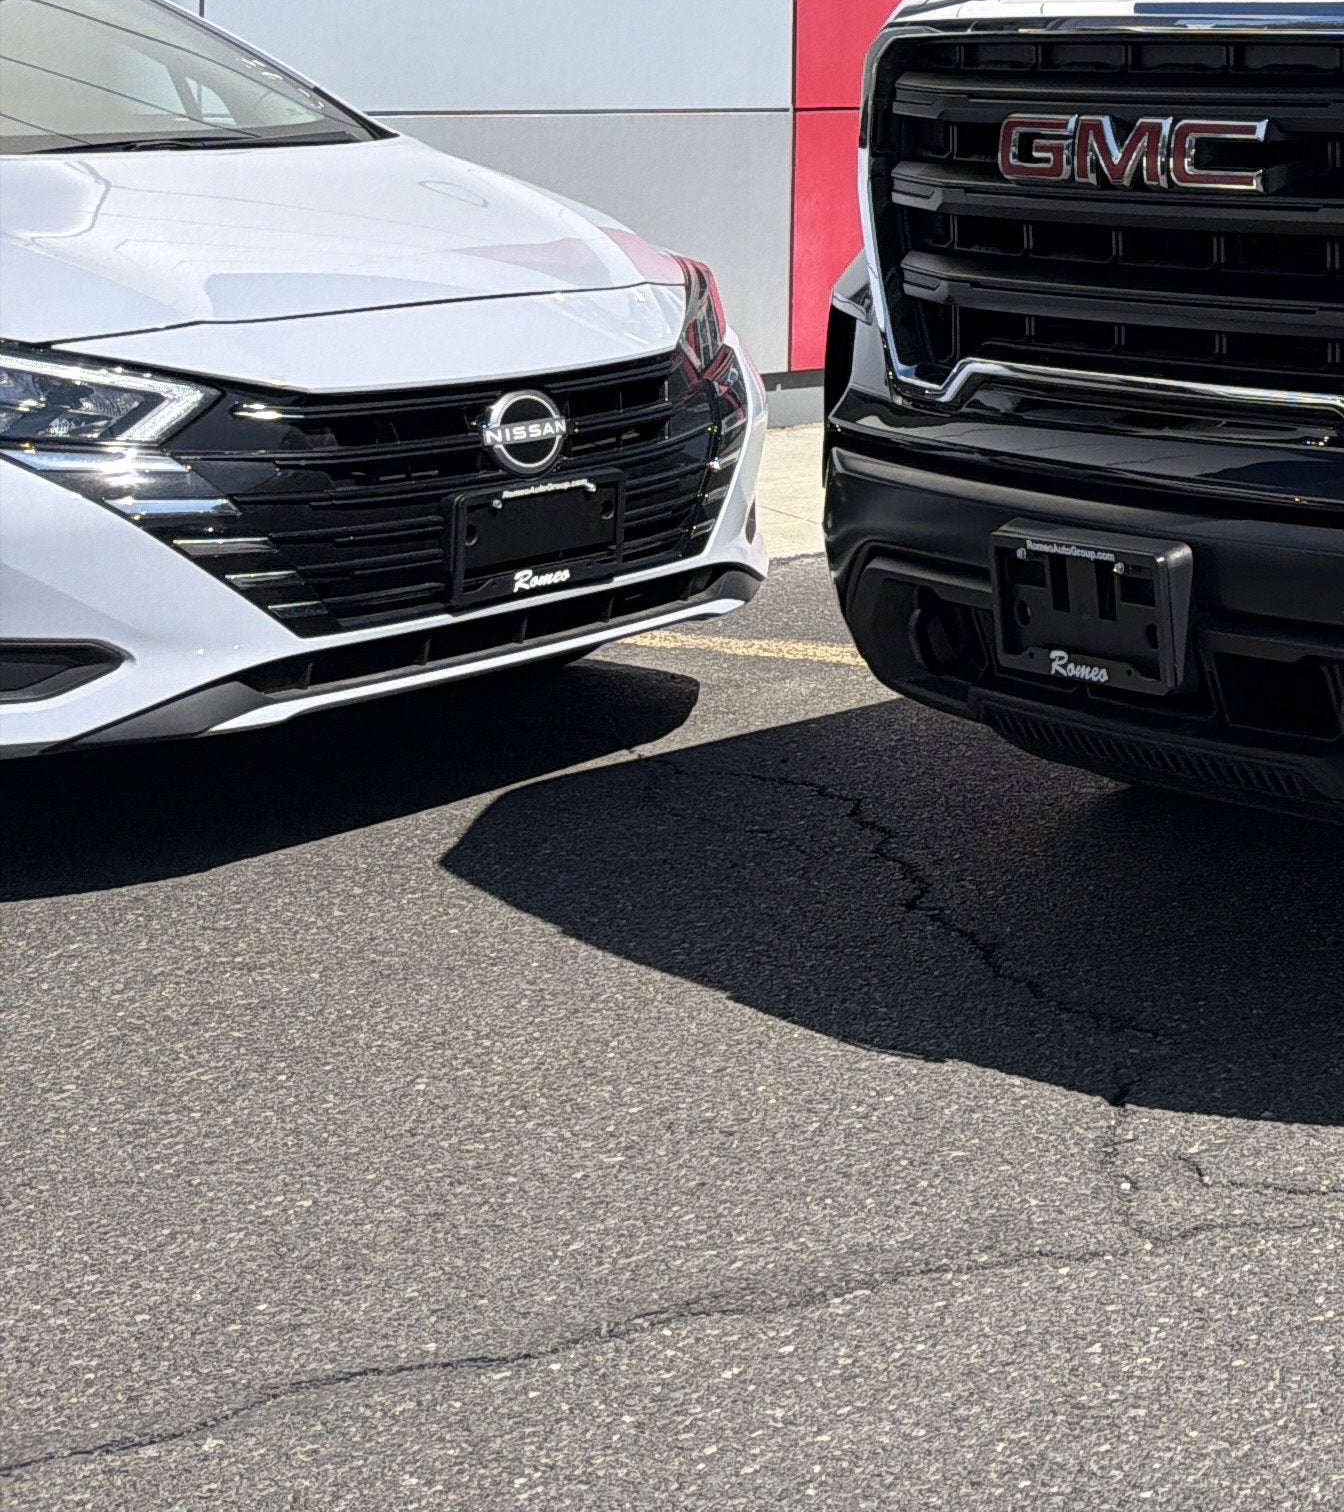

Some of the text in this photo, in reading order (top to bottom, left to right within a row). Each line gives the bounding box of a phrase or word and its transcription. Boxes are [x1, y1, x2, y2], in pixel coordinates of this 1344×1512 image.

[998, 113, 1270, 193] GMC
[485, 418, 567, 444] NISSAN
[1025, 539, 1116, 562] RomeoAutoGroup.com
[512, 568, 571, 593] Romeo
[1050, 650, 1109, 683] Romeo
